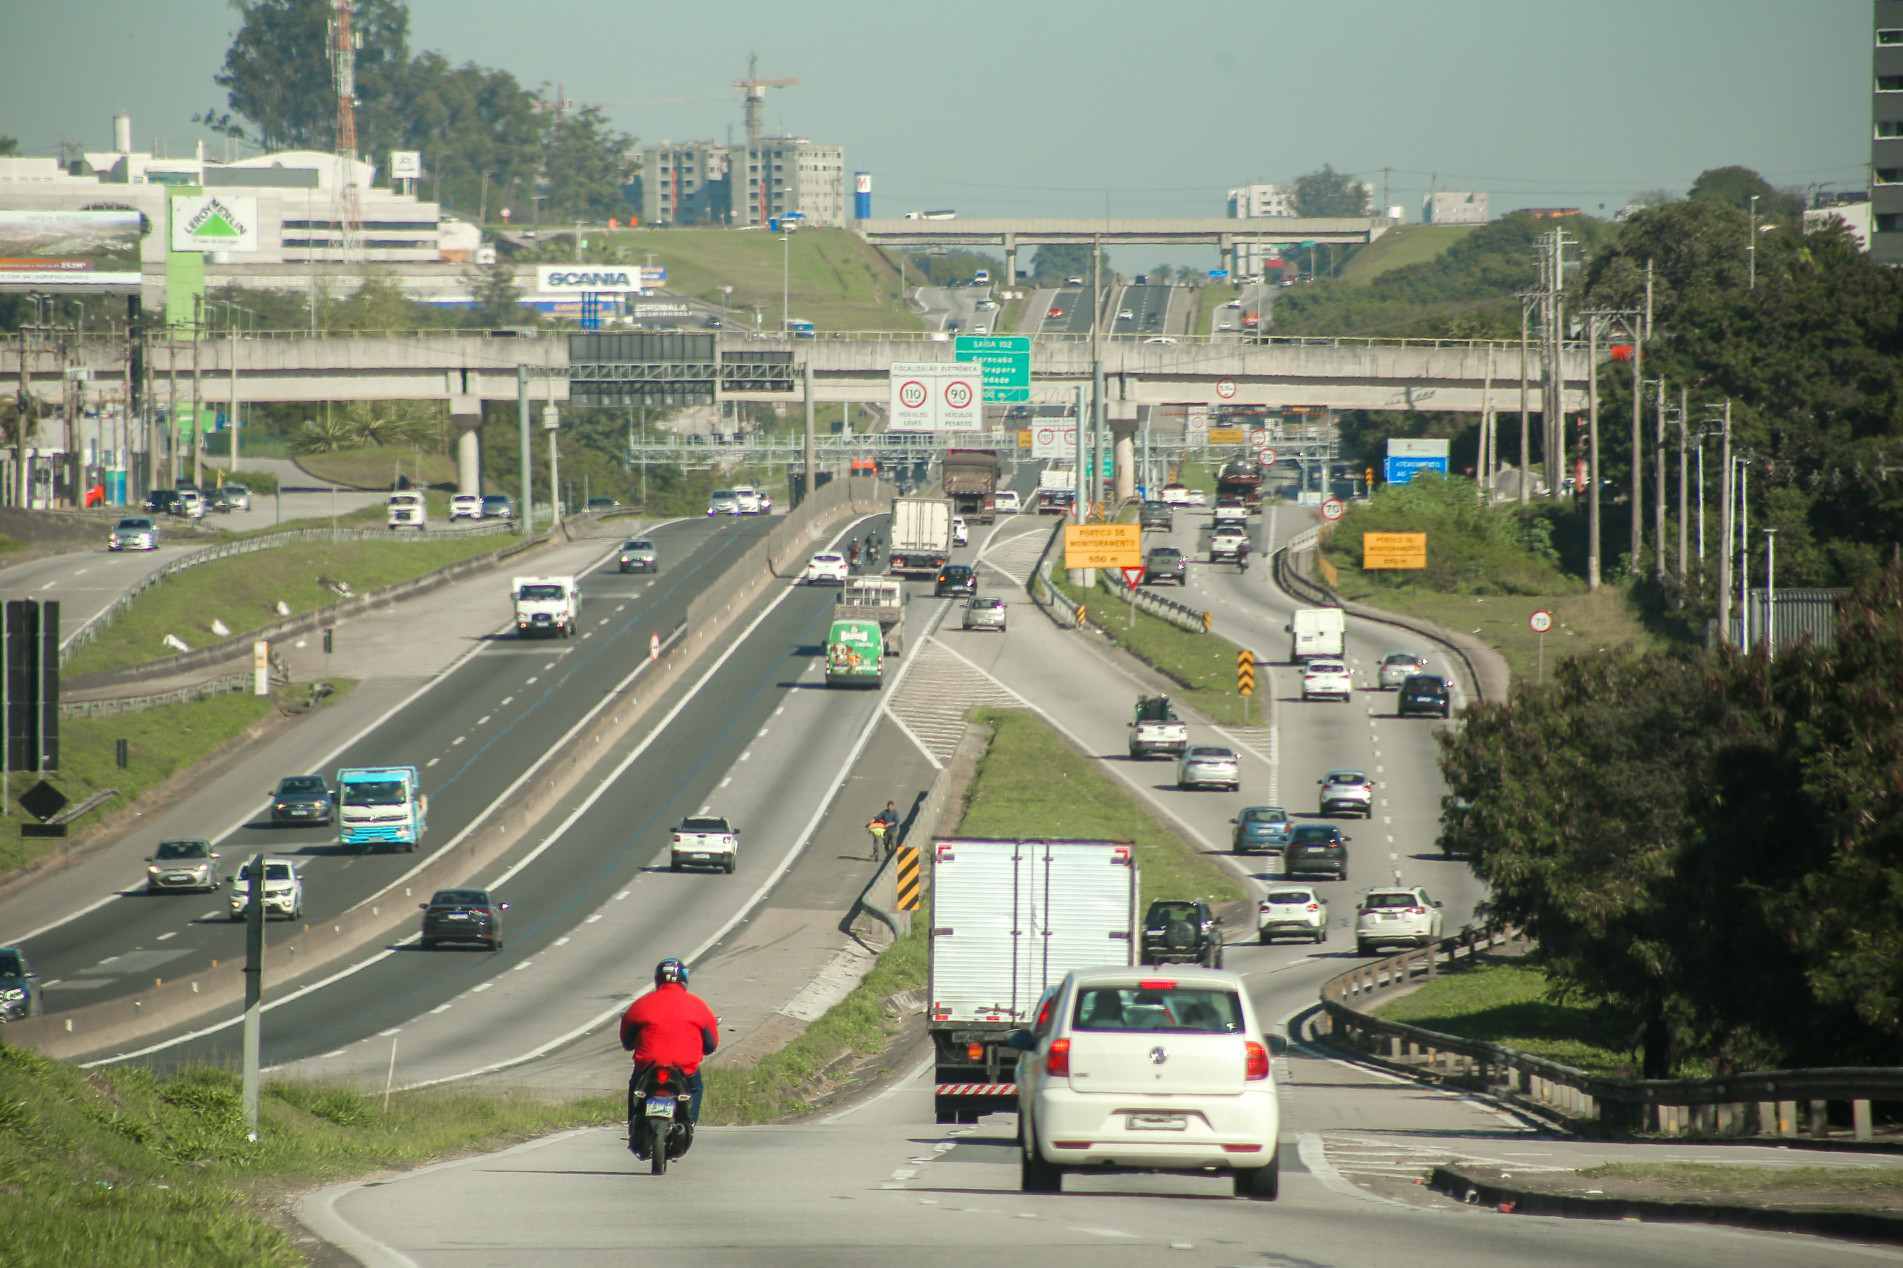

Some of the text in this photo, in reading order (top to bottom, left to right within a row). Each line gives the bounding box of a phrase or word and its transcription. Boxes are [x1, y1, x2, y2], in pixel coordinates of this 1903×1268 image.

[184, 196, 247, 235] LEROY MERLIN
[548, 272, 630, 287] SCANIA
[904, 388, 922, 399] 110
[950, 389, 967, 401] 90
[1327, 504, 1339, 513] 70
[1536, 617, 1547, 626] 70
